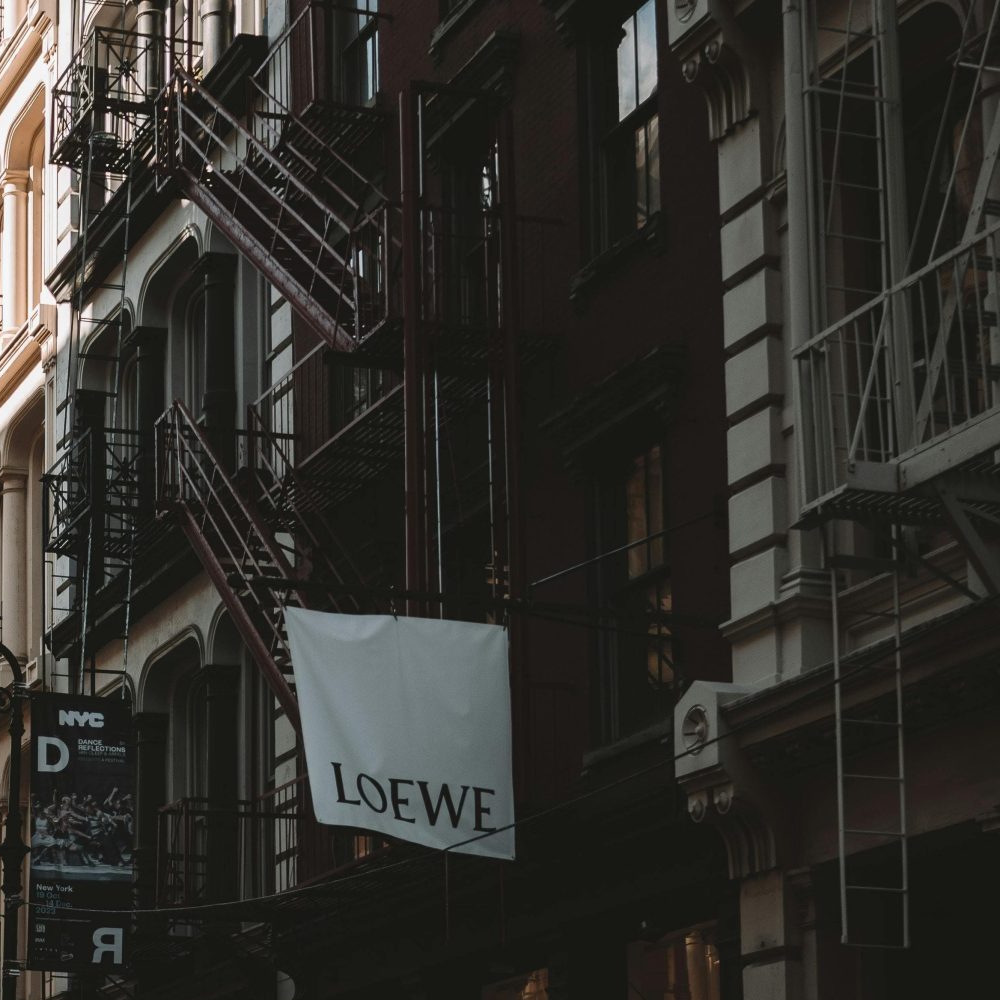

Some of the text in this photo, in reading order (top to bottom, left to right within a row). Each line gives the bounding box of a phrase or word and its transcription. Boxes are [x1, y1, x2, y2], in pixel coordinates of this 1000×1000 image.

[58, 709, 105, 728] NYC
[37, 736, 70, 773] D
[78, 745, 126, 753] REFLECTIONS
[331, 762, 496, 832] LOEWE
[36, 883, 73, 893] New York
